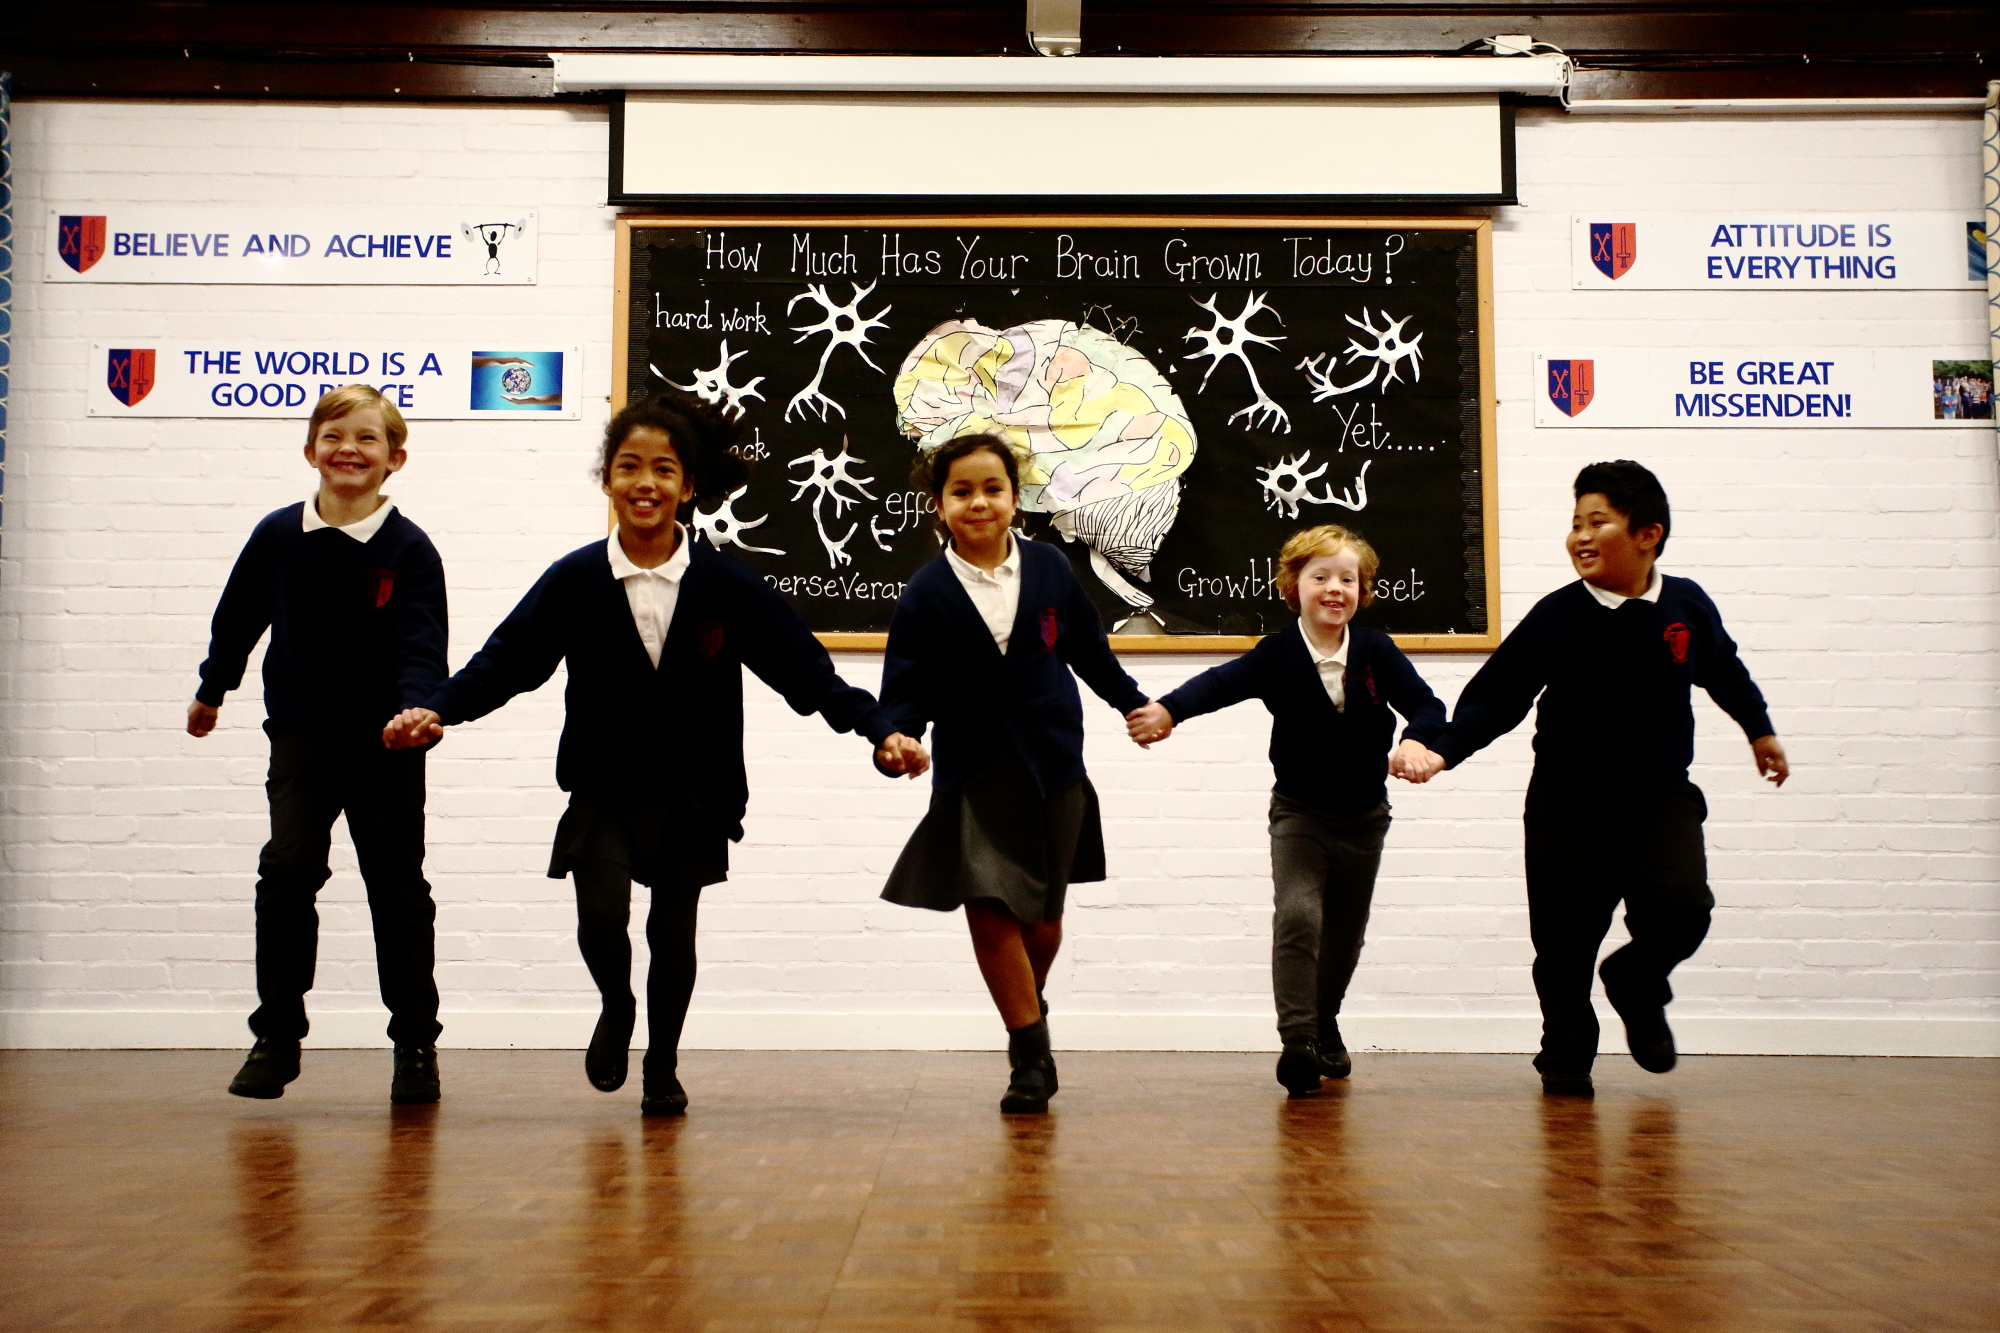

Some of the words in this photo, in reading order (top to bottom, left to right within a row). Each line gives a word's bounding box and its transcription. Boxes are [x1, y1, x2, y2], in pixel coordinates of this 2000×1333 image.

[114, 233, 228, 257] BELIEVE
[242, 234, 310, 257] AND
[324, 234, 451, 258] ACHIEVE
[1711, 224, 1856, 248] ATTITUDE
[1868, 224, 1892, 248] IS
[705, 231, 762, 273] How
[790, 232, 858, 277] Much
[881, 233, 942, 276] Has
[956, 235, 1029, 280] Your
[1056, 234, 1140, 280] Brain
[1164, 238, 1262, 282] Grown
[1707, 255, 1897, 279] EVERYTHING
[655, 291, 713, 330] hard
[720, 301, 772, 336] work
[183, 350, 242, 374] THE
[254, 350, 370, 375] WORLD
[381, 351, 405, 376] IS
[418, 352, 443, 376] A
[1690, 361, 1725, 385] BE
[1736, 361, 1835, 386] GREAT
[210, 382, 307, 407] GOOD
[1675, 393, 1852, 418] MISSENDEN!
